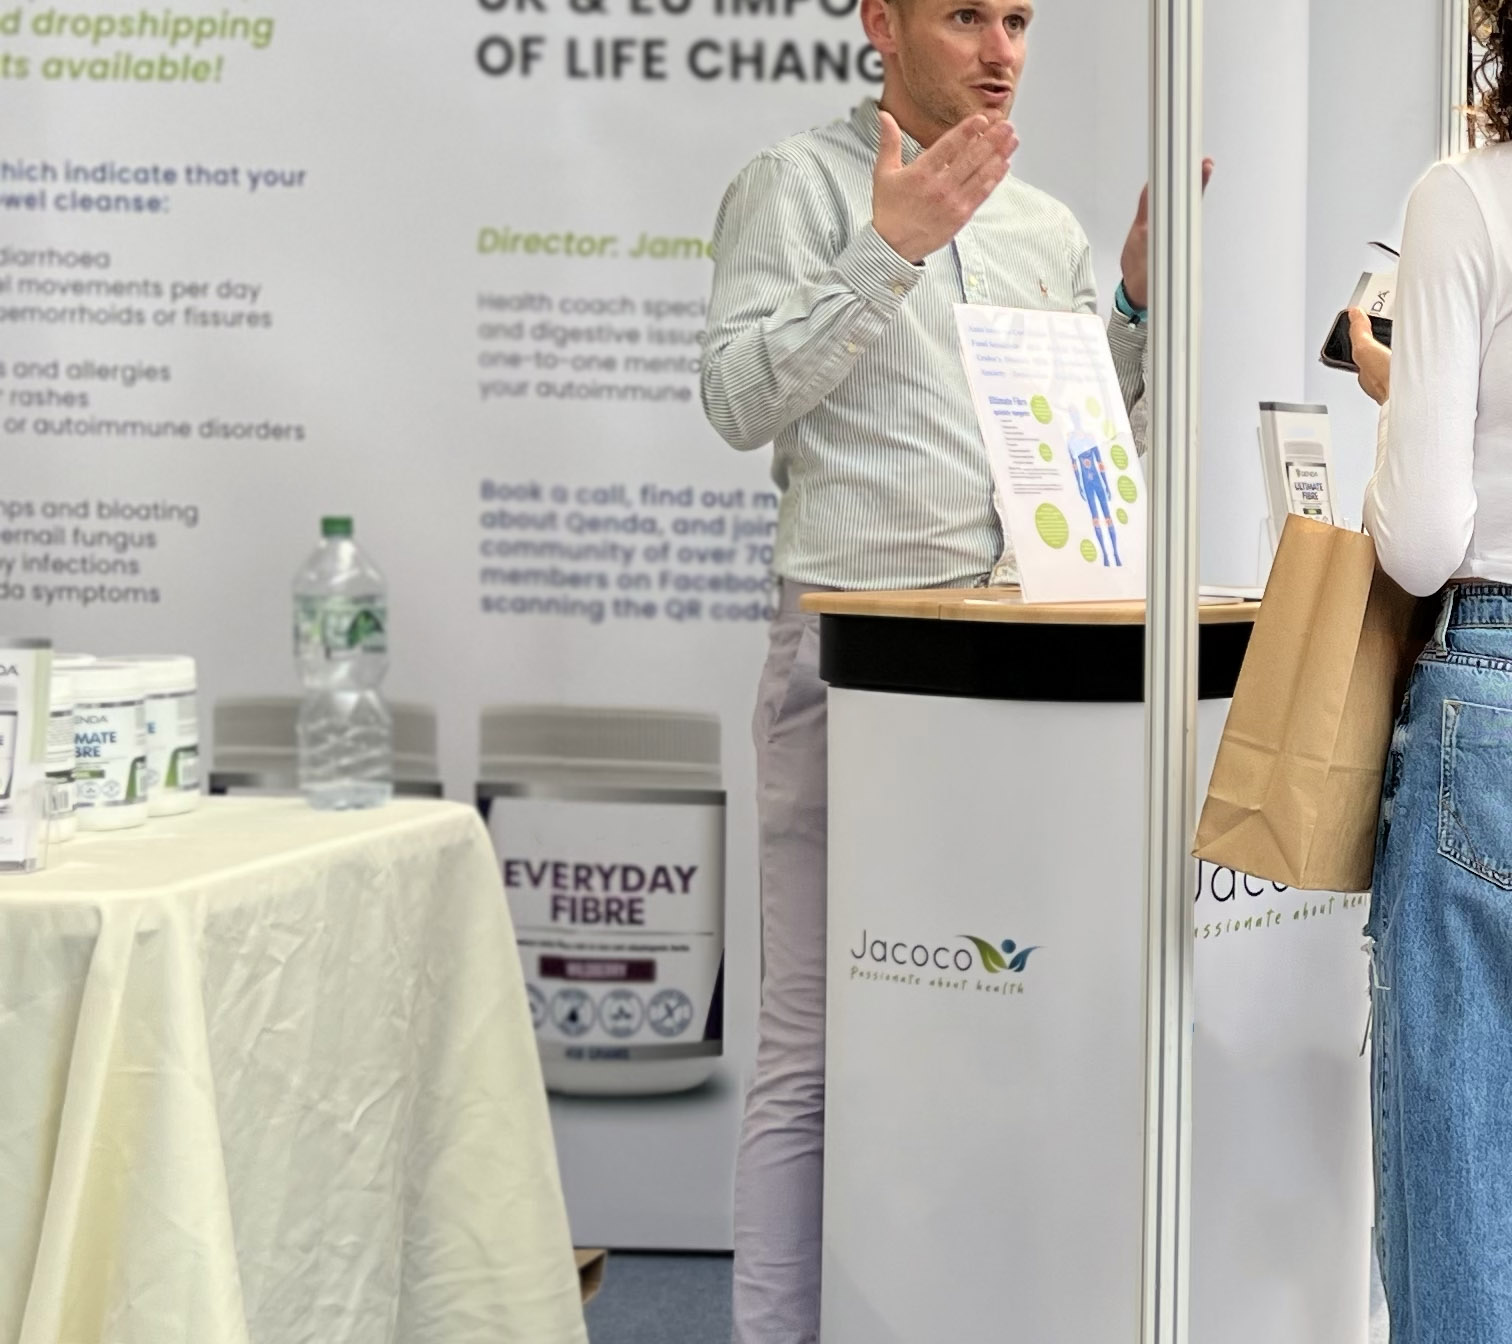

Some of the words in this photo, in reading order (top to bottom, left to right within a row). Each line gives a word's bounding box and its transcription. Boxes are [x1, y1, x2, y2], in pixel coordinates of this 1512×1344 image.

[32, 8, 275, 50] dropshipping
[41, 54, 224, 83] available!
[475, 35, 546, 78] OF
[566, 37, 667, 80] LIFE
[64, 162, 178, 187] indicate
[185, 164, 239, 187] that
[248, 167, 307, 192] your
[0, 189, 46, 212] wel
[54, 190, 171, 214] cleanse:
[18, 276, 163, 300] movements
[171, 278, 209, 304] per
[216, 278, 261, 305] day
[152, 309, 178, 327] or
[184, 308, 272, 329] fissures
[13, 360, 59, 380] and
[66, 360, 171, 387] allergies
[10, 388, 89, 407] rashes
[4, 418, 26, 434] or
[33, 417, 191, 438] autoimmune
[198, 419, 305, 441] disorders
[42, 500, 89, 520] and
[97, 501, 198, 528] bloating
[73, 528, 156, 554] fungus
[23, 554, 139, 575] infections
[32, 583, 160, 606] symptoms
[504, 860, 698, 894] EVERYDAY
[551, 895, 645, 926] FIBRE
[851, 929, 973, 971] Jacoco
